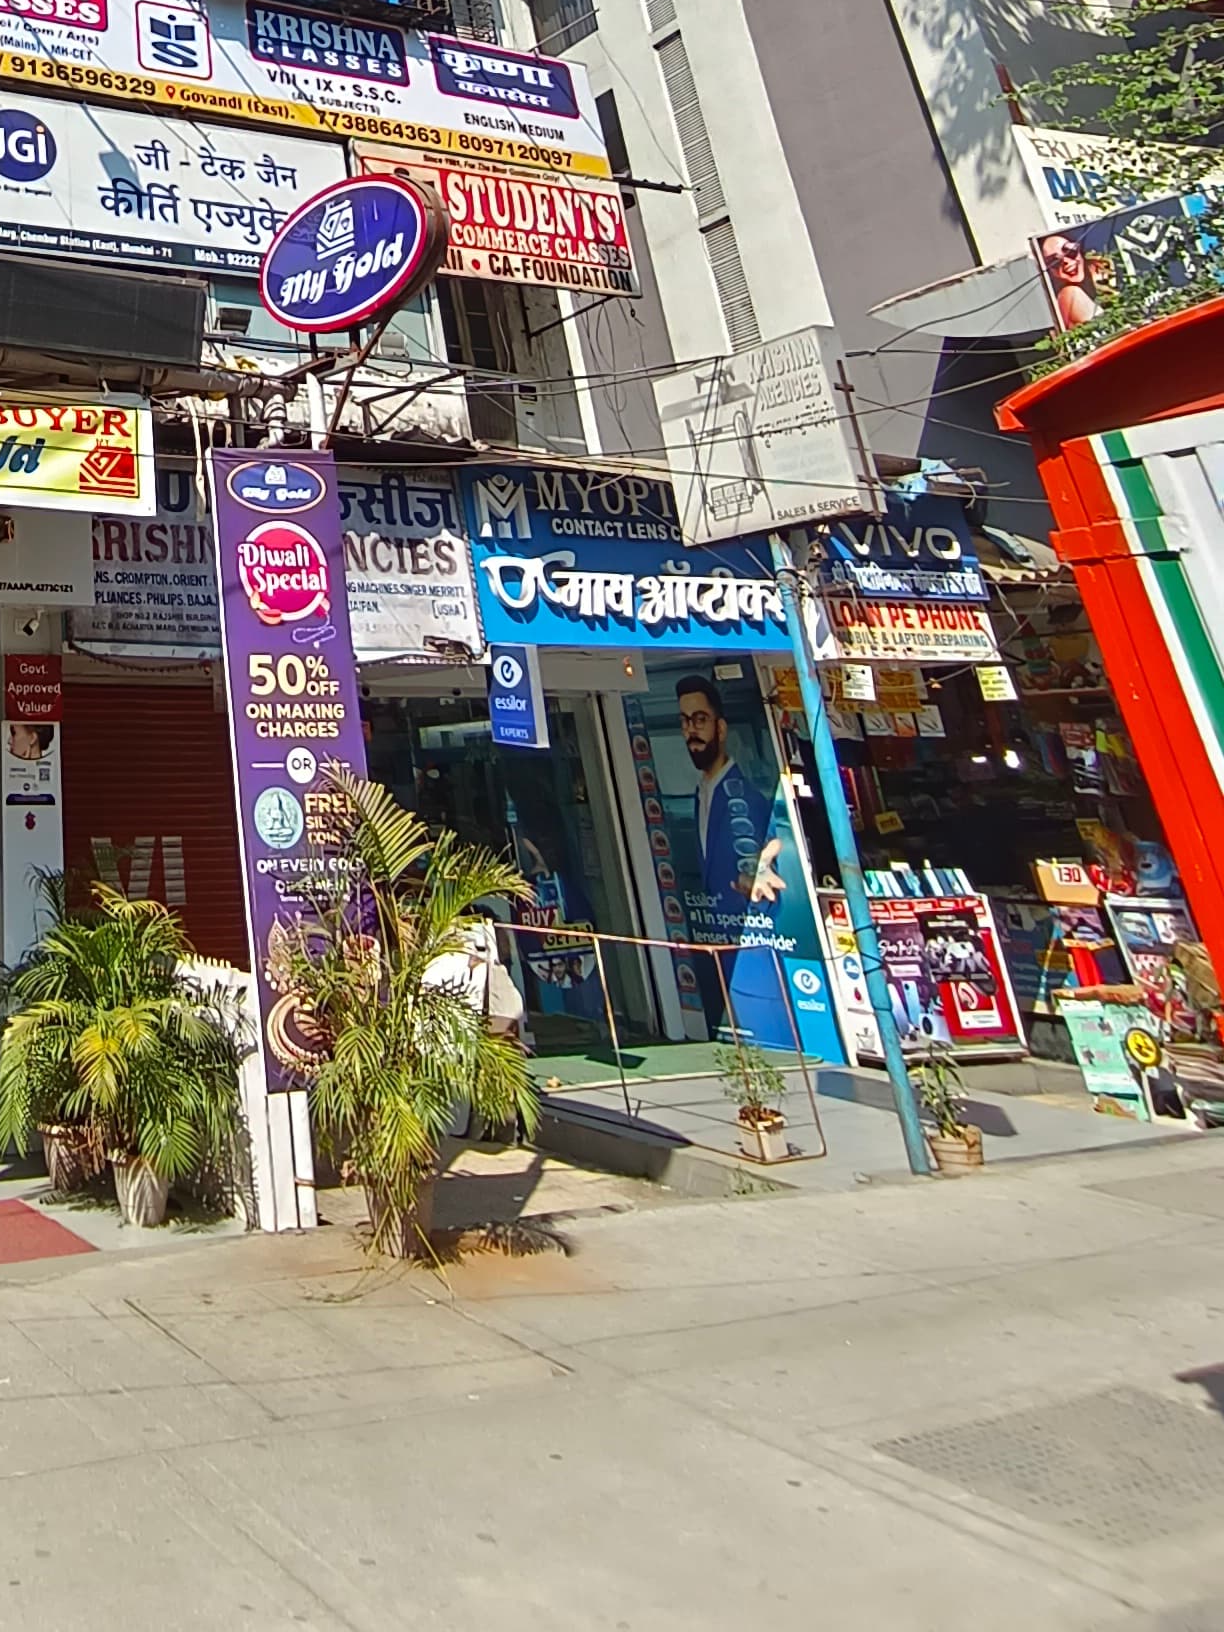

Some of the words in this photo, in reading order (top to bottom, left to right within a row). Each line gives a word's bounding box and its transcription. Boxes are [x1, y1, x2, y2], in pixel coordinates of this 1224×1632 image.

[254, 8, 400, 62] KRISHNA
[256, 37, 403, 79] CLASSES
[10, 54, 157, 98] 9136596329
[351, 83, 403, 105] S.S.C.
[179, 88, 244, 110] Govandi
[316, 108, 442, 146] 7738864363
[458, 133, 574, 168] 8097120097
[463, 112, 516, 135] ENGLISH
[517, 123, 565, 143] MEDIUM
[132, 139, 171, 172] जी
[197, 145, 246, 182] टेक
[254, 153, 298, 191] जैन
[97, 175, 180, 225] कीर्ति
[446, 172, 622, 243] STUDENTS'
[451, 223, 553, 256] COMMERCE
[554, 237, 631, 268] CLASSES
[279, 268, 328, 307] My
[332, 231, 405, 296] Gold
[487, 252, 634, 293] CA-FOUNDATION
[776, 506, 808, 522] SALES
[817, 495, 860, 514] SERVICE
[551, 518, 624, 540] CONTACT
[627, 520, 669, 542] LENS
[837, 521, 963, 560] VIVO
[236, 543, 311, 567] Diwali
[252, 566, 328, 594] Special
[829, 599, 885, 628] LOAN
[887, 601, 916, 630] PE
[919, 602, 984, 632] PHONE
[892, 632, 932, 648] LAPTOP
[934, 633, 989, 649] REPAIRING
[19, 662, 49, 675] Govt.
[7, 681, 62, 696] Approved
[306, 680, 340, 697] OFF
[16, 700, 52, 714] Valuer
[245, 702, 273, 720] ON
[275, 703, 346, 721] MAKING
[494, 694, 528, 714] essilor
[255, 721, 340, 739] CHARGES
[498, 725, 530, 740] EXPERTS
[290, 757, 313, 771] OR
[717, 911, 775, 931] spectacle
